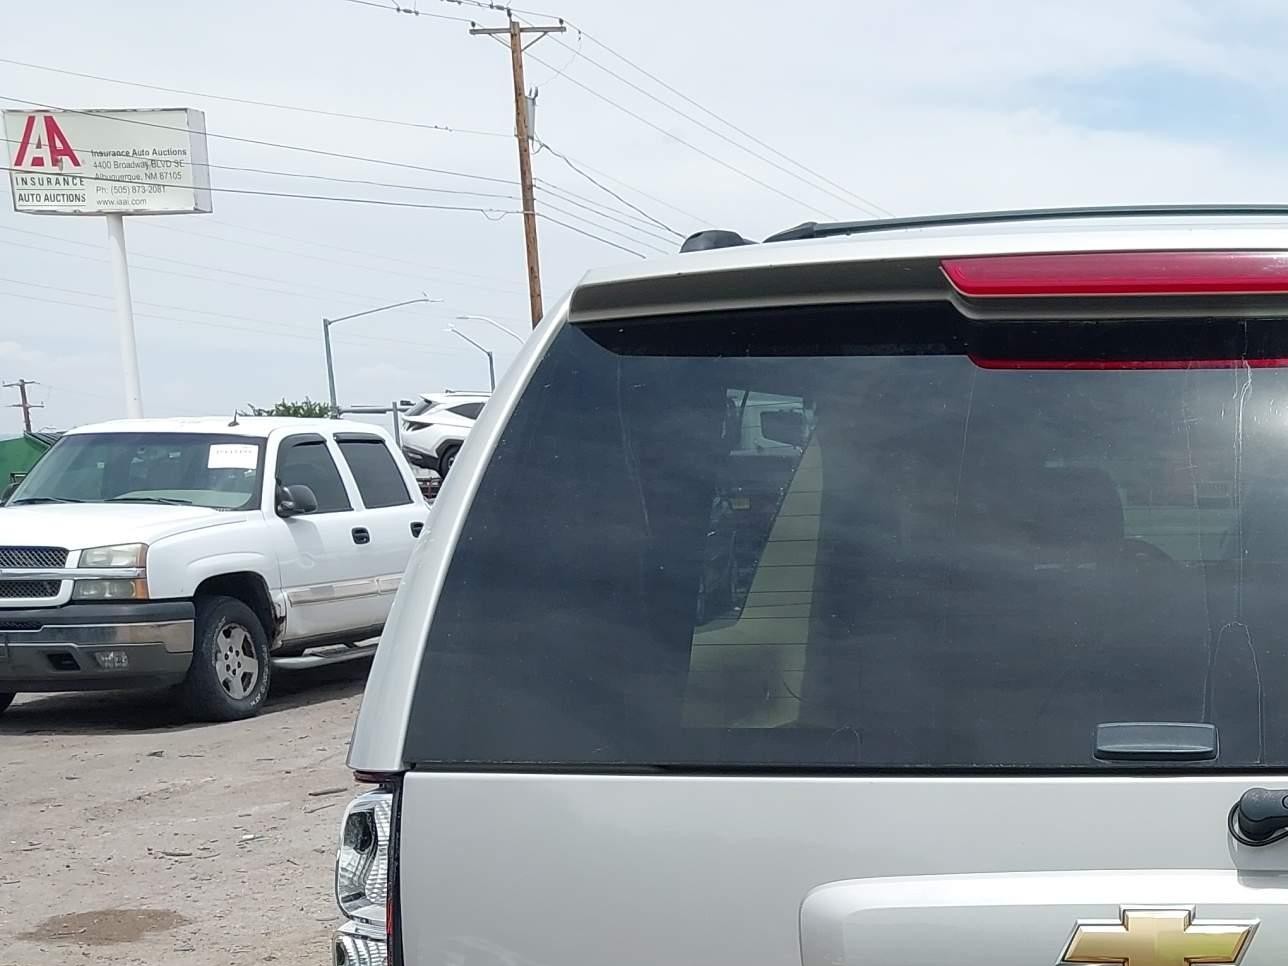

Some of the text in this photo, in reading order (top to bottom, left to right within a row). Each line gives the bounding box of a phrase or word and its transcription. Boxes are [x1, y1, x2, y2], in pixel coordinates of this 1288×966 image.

[91, 147, 187, 157] Insurance Auto Auctions
[93, 161, 111, 169] 4400
[113, 160, 149, 170] Broadway
[151, 160, 172, 169] BLVD
[144, 172, 158, 180] NM
[159, 171, 182, 180] 87105
[15, 176, 85, 186] INSURANCE
[110, 186, 130, 195] (505)
[18, 193, 86, 203] AUTO AUCTIONS
[96, 198, 147, 206] www.iaai.com
